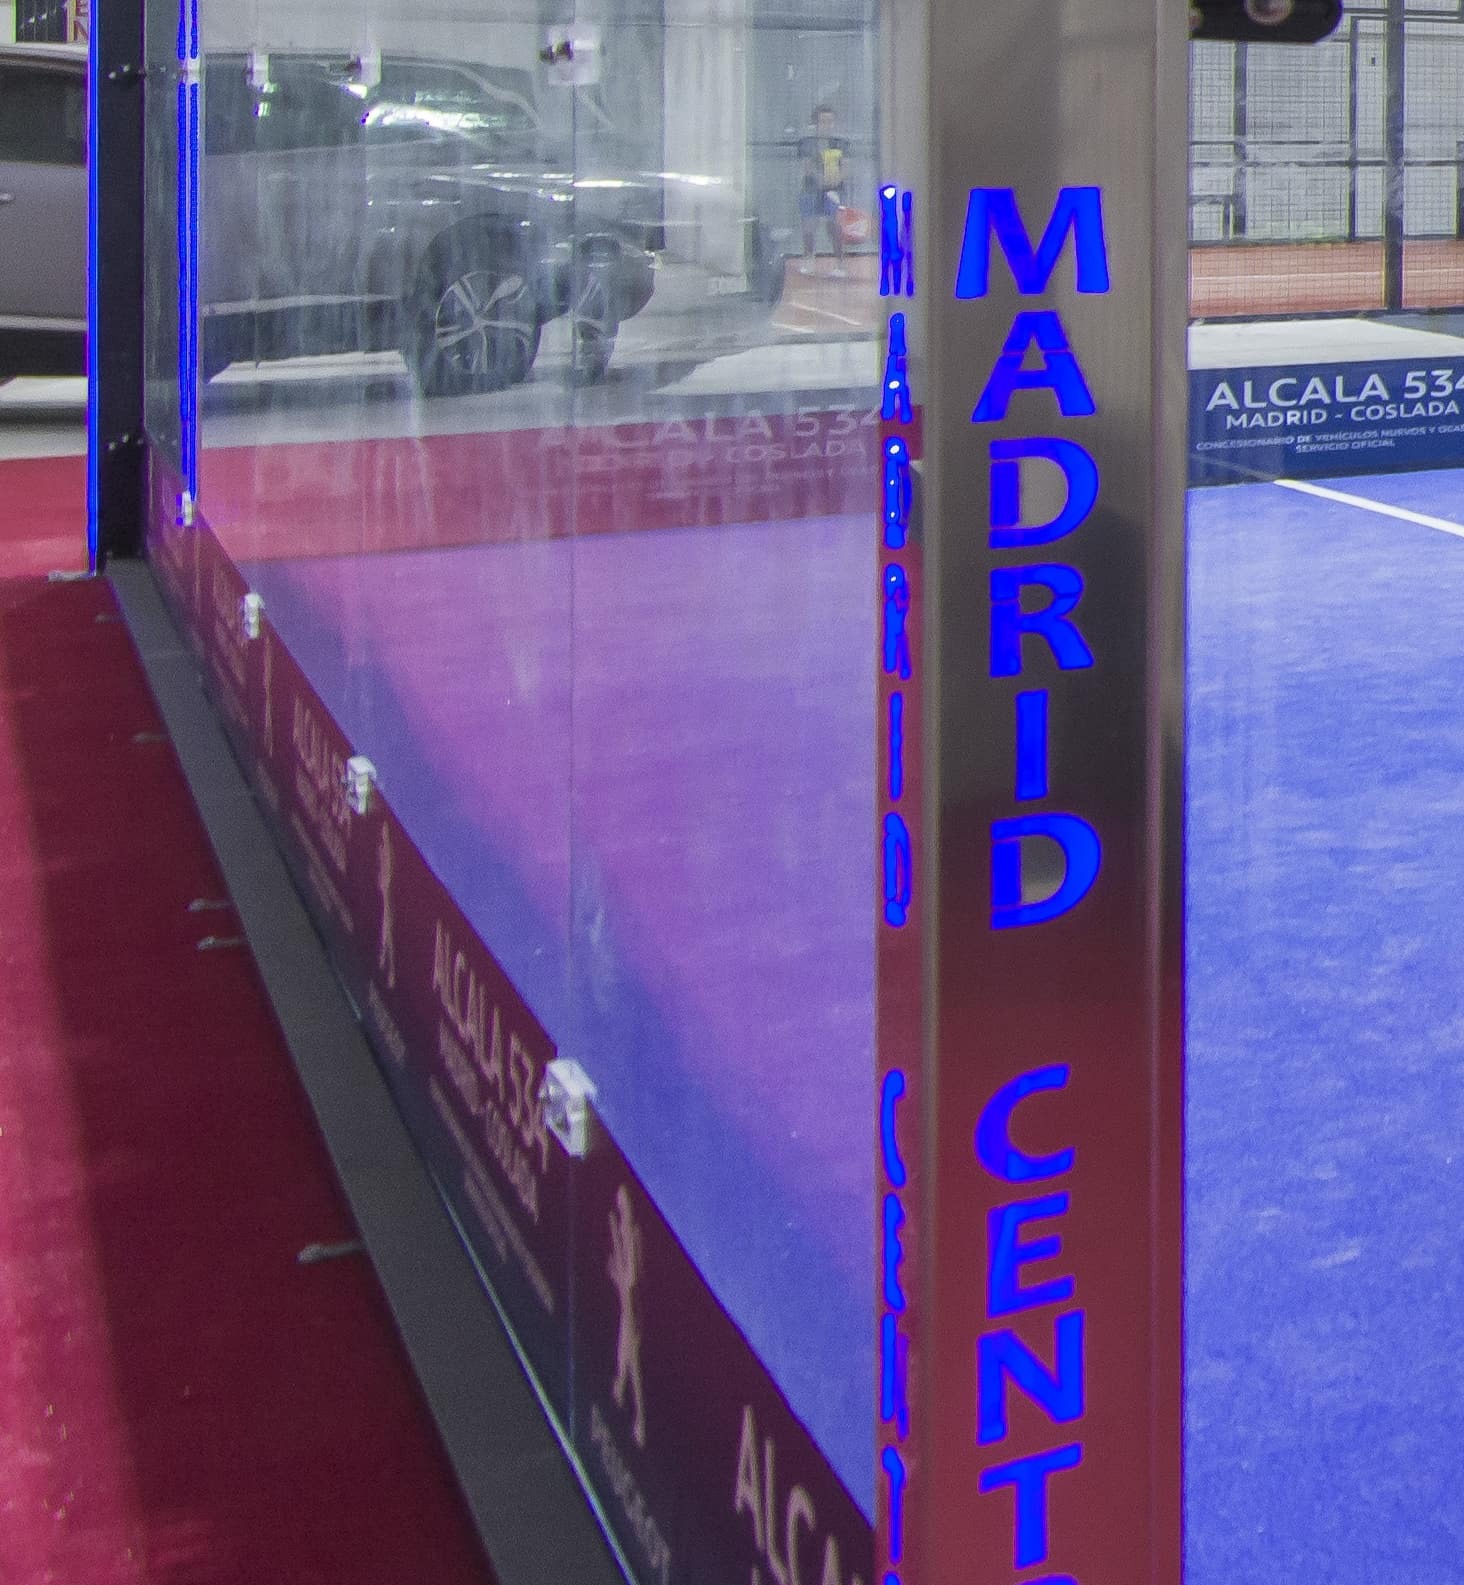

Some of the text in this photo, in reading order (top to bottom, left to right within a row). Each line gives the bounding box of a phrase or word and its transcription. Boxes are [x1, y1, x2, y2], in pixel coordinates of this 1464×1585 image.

[1206, 372, 1390, 412] ALCALA
[1226, 408, 1327, 430] MADRID
[1351, 398, 1460, 422] COSLADA
[955, 186, 1111, 930] MADRID
[973, 1063, 1086, 1585] CENT
